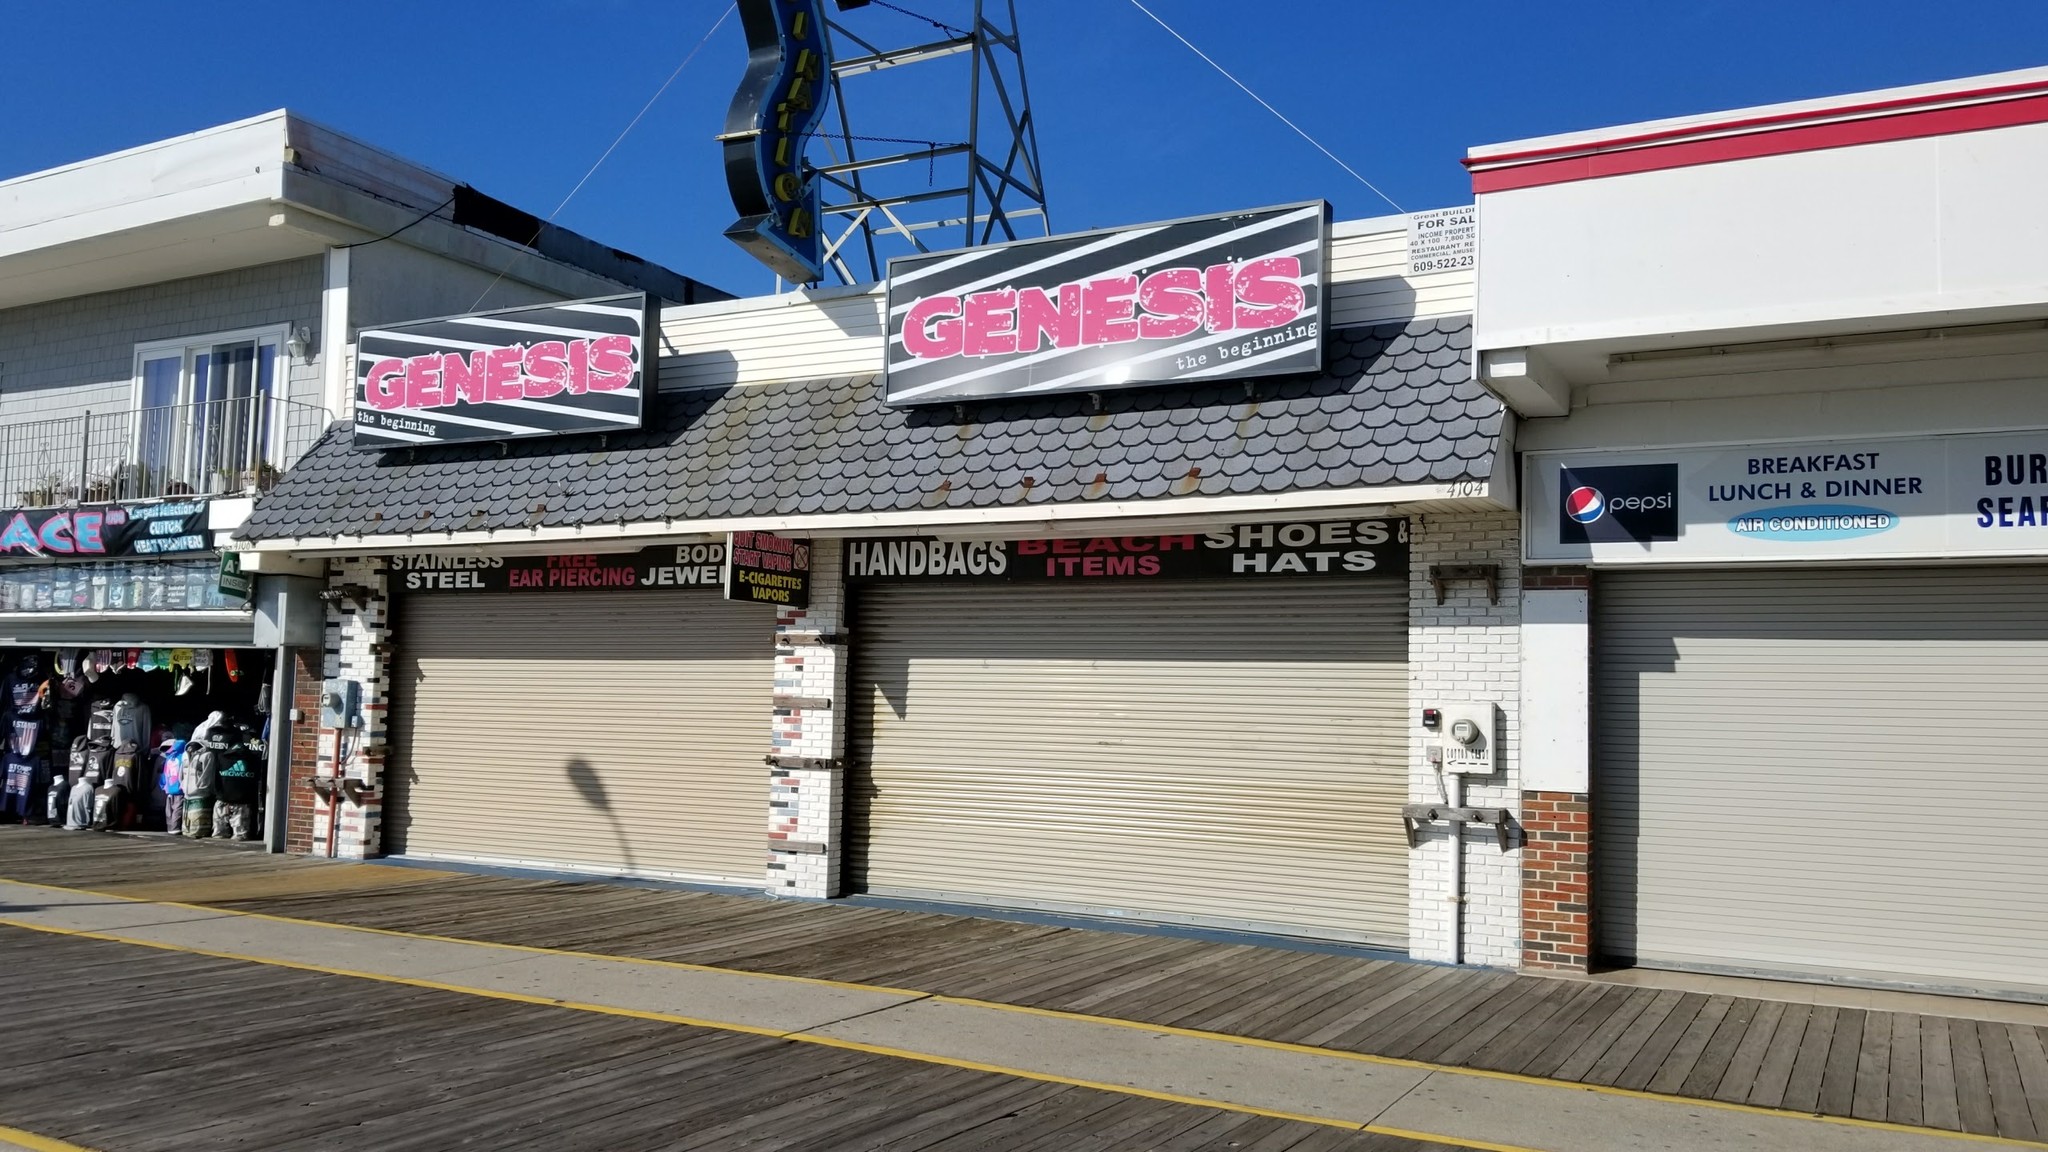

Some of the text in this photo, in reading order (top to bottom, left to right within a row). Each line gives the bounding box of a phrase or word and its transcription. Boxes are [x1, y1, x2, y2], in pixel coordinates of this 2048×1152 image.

[774, 8, 820, 238] INATION
[1413, 212, 1439, 220] Great
[1417, 215, 1475, 230] FOR SAL
[1417, 230, 1443, 239] INCOME
[1444, 235, 1464, 243] 7,800
[1411, 242, 1461, 254] RESTAURANT
[1413, 255, 1474, 273] 609-522-23
[902, 256, 1305, 360] GENESIS
[1175, 321, 1317, 371] the beginning
[364, 335, 634, 410] GENESIS
[357, 410, 437, 436] the beginning
[1747, 452, 1880, 476] BREAKFAST
[1984, 453, 2048, 486] BUR
[1446, 479, 1484, 498] 4104
[1708, 477, 1923, 502] LUNCH & DINNER
[1608, 491, 1672, 514] pepsi
[0, 511, 106, 553] ACE
[149, 519, 183, 536] CUSTOM
[1735, 514, 1891, 533] AIR CONDITIONED
[733, 531, 793, 556] QUIT SMOKING
[1016, 533, 1196, 556] BEACH
[1203, 520, 1390, 551] SHOES
[134, 539, 159, 554] HEAT
[675, 544, 727, 565] BOD
[391, 553, 505, 572] STAINLESS
[546, 554, 598, 569] FREE
[732, 548, 792, 573] START VAPING
[847, 539, 1008, 577] HANDBAGS
[1045, 555, 1162, 578] ITEMS
[1231, 550, 1378, 574] HATS
[405, 570, 486, 589] STEEL
[508, 566, 636, 588] EAR PIERCING
[739, 569, 802, 590] E-CIGARETTES
[751, 586, 790, 603] VAPORS
[16, 720, 37, 730] STAND
[1446, 748, 1468, 760] COTTON
[8, 763, 33, 771] STOMP
